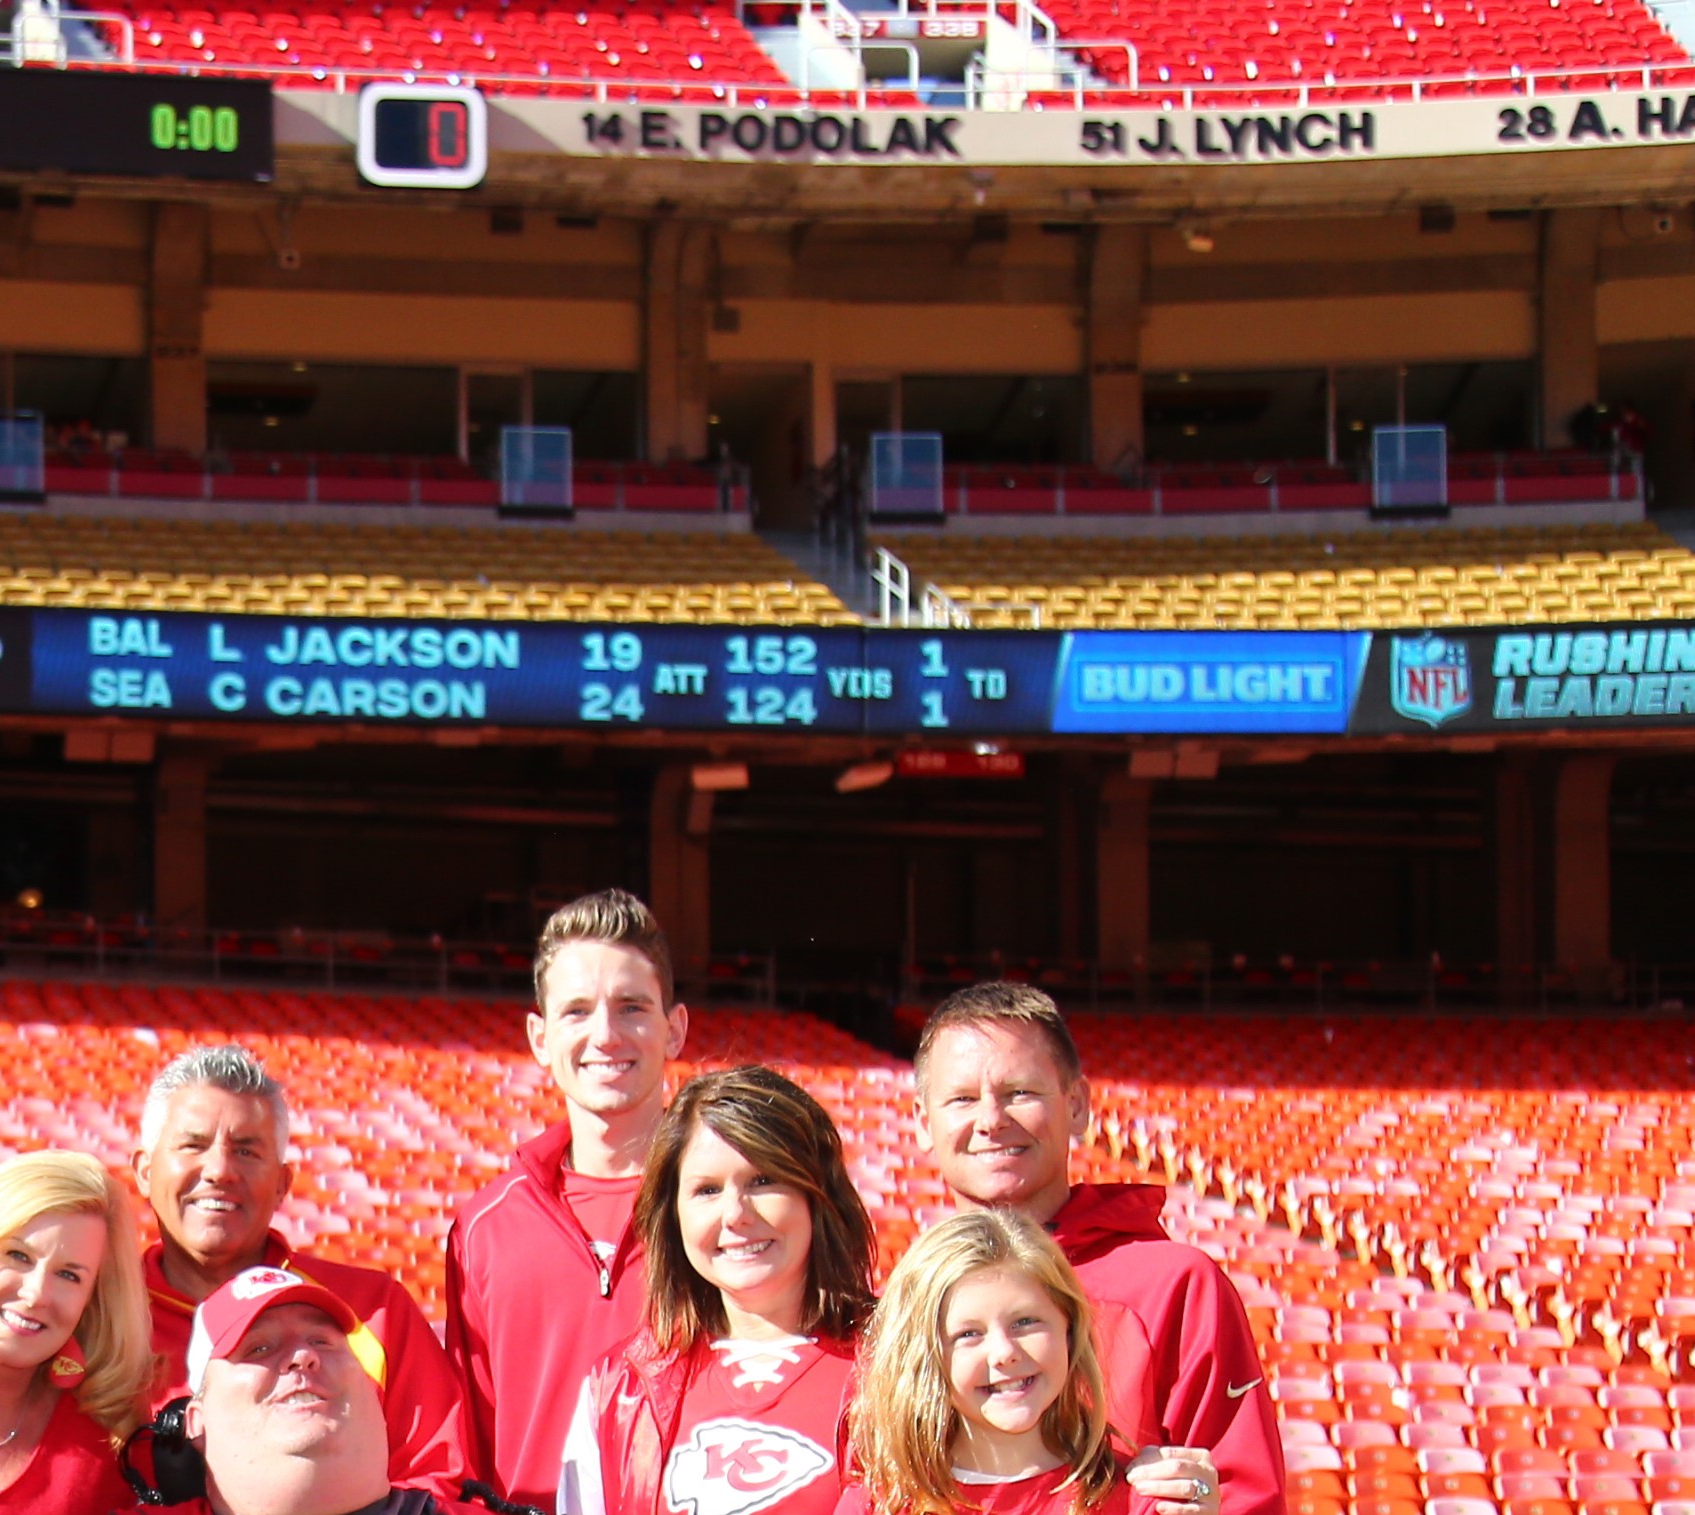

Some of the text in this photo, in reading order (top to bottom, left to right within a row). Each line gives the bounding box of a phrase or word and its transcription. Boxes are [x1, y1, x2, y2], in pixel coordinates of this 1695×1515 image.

[150, 103, 239, 152] 0:00
[427, 102, 467, 166] 0
[582, 111, 961, 155] 14 E. PODOLAK
[1080, 112, 1374, 157] 51 J. LYNCH
[1497, 108, 1555, 142] 28
[1569, 100, 1624, 141] A.
[89, 617, 950, 678] BAL L JACKSON 19 152 1
[88, 667, 950, 729] SEA C CARSON 24 124 1
[652, 663, 708, 696] ATT
[826, 667, 893, 700] YDS
[964, 669, 1007, 700] TD
[1082, 662, 1334, 702] BUD LIGHT
[1406, 665, 1469, 706] NFL
[703, 1438, 789, 1492] KC
